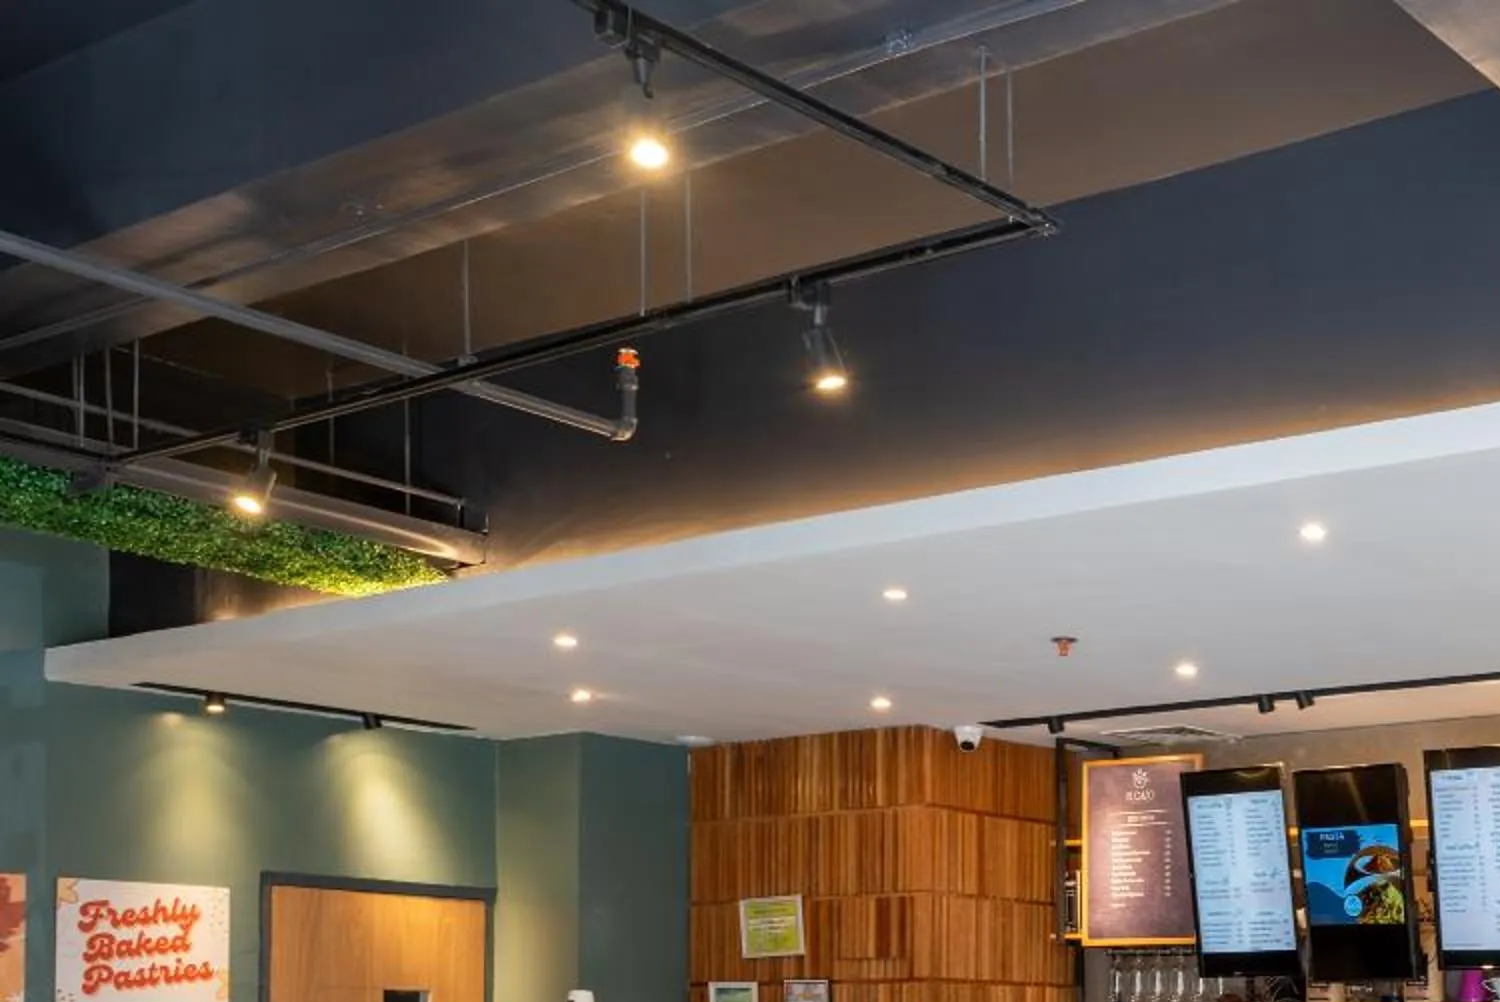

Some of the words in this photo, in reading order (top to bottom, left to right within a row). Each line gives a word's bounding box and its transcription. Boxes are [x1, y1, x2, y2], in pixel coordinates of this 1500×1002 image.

[78, 897, 201, 932] Freshly
[83, 929, 193, 963] Baked
[81, 958, 216, 995] Pastries
